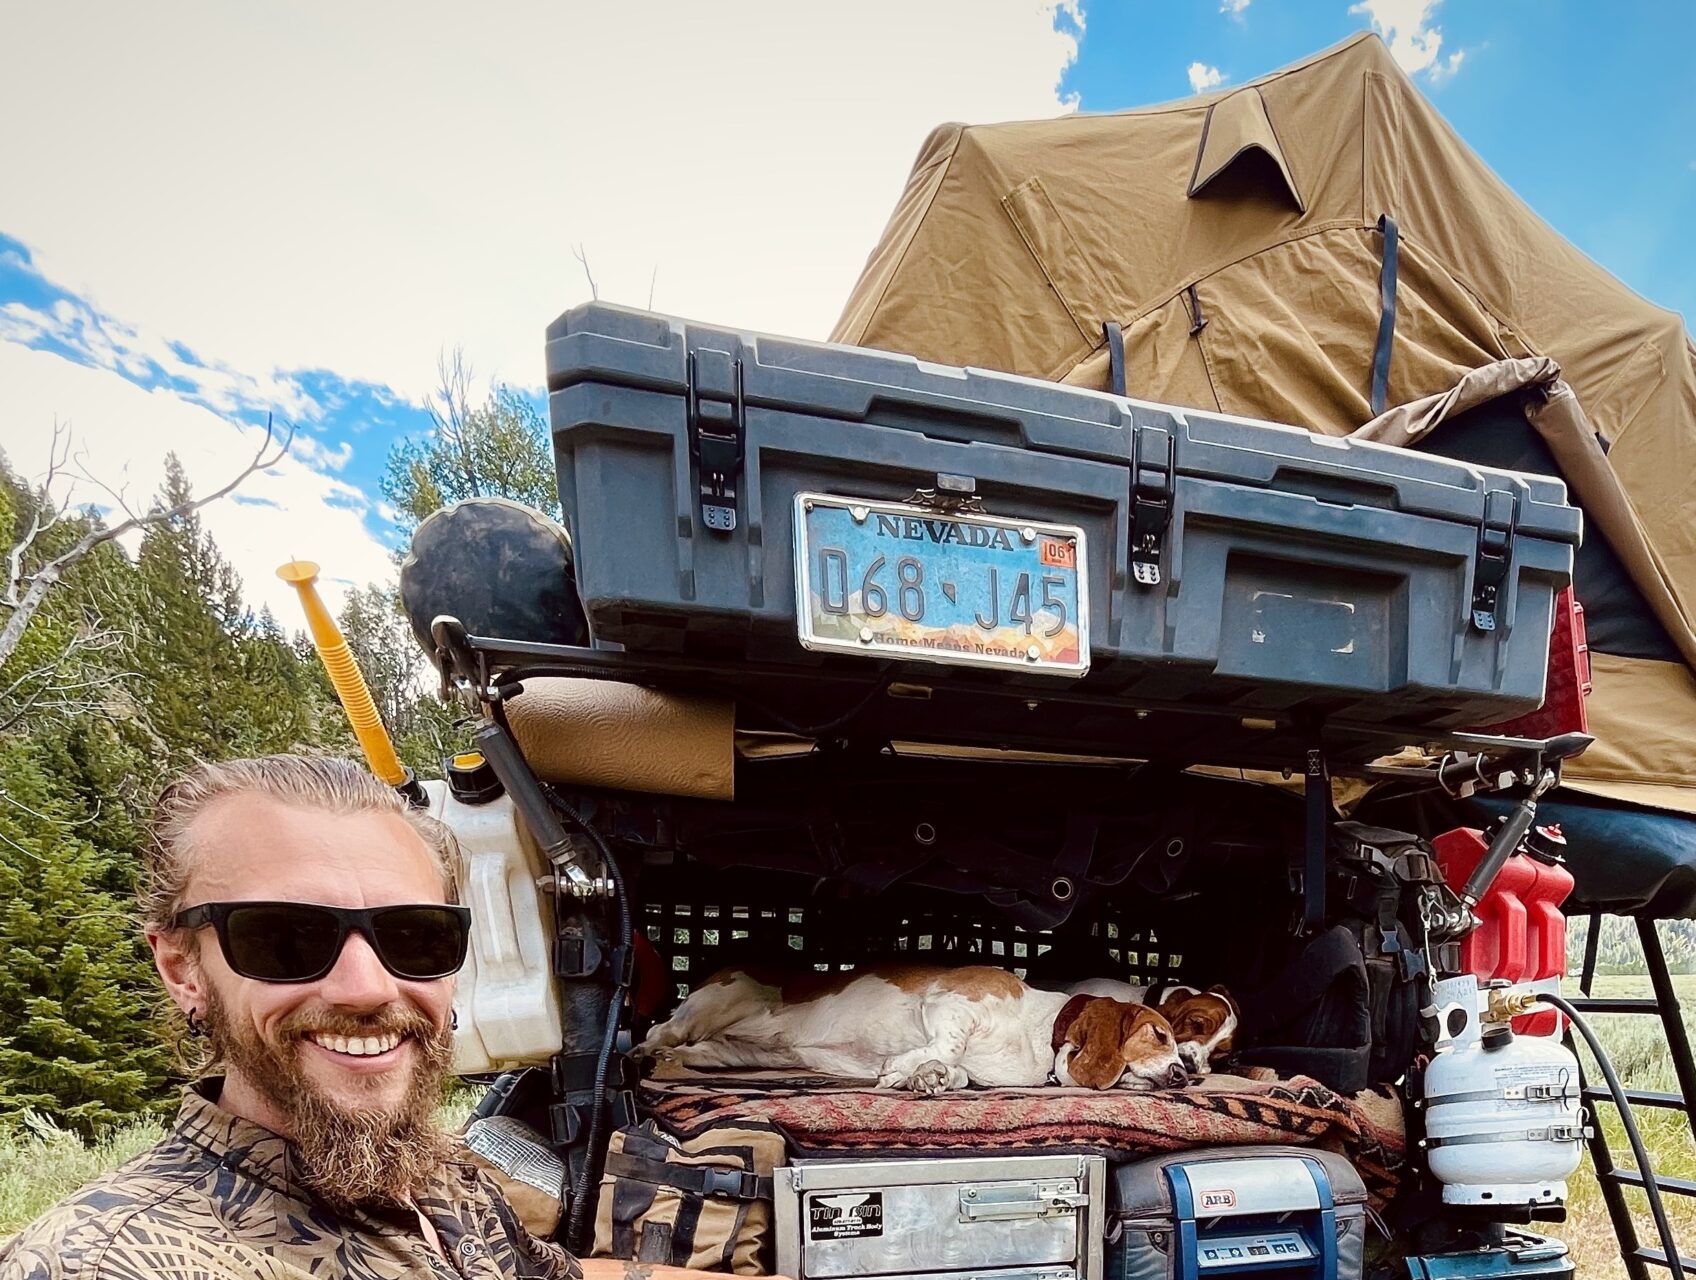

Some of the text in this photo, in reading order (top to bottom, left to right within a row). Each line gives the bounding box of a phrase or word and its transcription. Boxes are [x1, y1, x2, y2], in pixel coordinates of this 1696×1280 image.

[877, 515, 1014, 551] NEVADA
[1049, 543, 1065, 559] 06
[821, 549, 1067, 637] 068 J45
[874, 632, 1026, 658] Home Means Nevada
[1206, 1195, 1231, 1206] ARB
